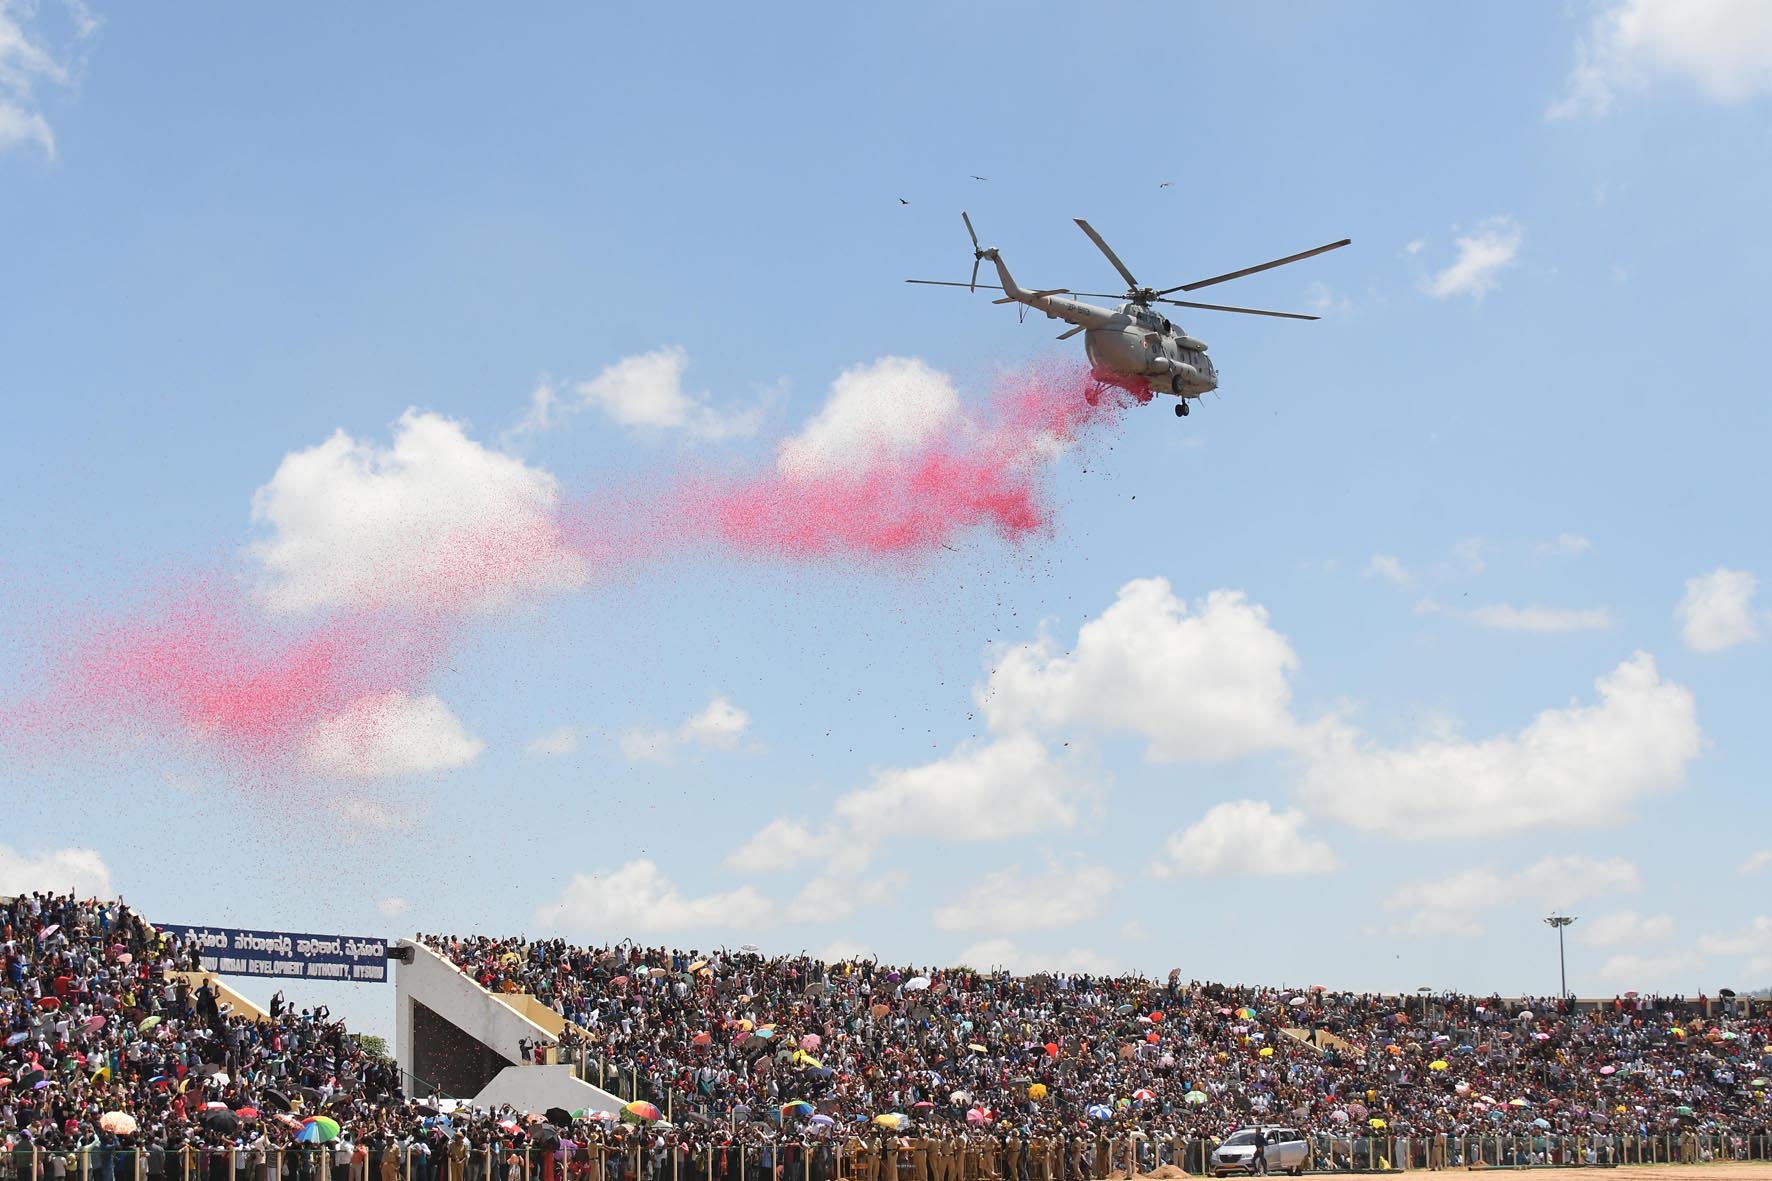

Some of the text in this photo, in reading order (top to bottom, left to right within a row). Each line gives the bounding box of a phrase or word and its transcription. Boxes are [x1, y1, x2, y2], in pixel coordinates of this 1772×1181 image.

[345, 939, 384, 960] ಮೈಸೂರು
[220, 957, 247, 972] URBAN
[248, 959, 305, 976] DEVELOPMENT
[306, 962, 351, 981] AUTHORITY,
[353, 964, 384, 979] MYSURU
